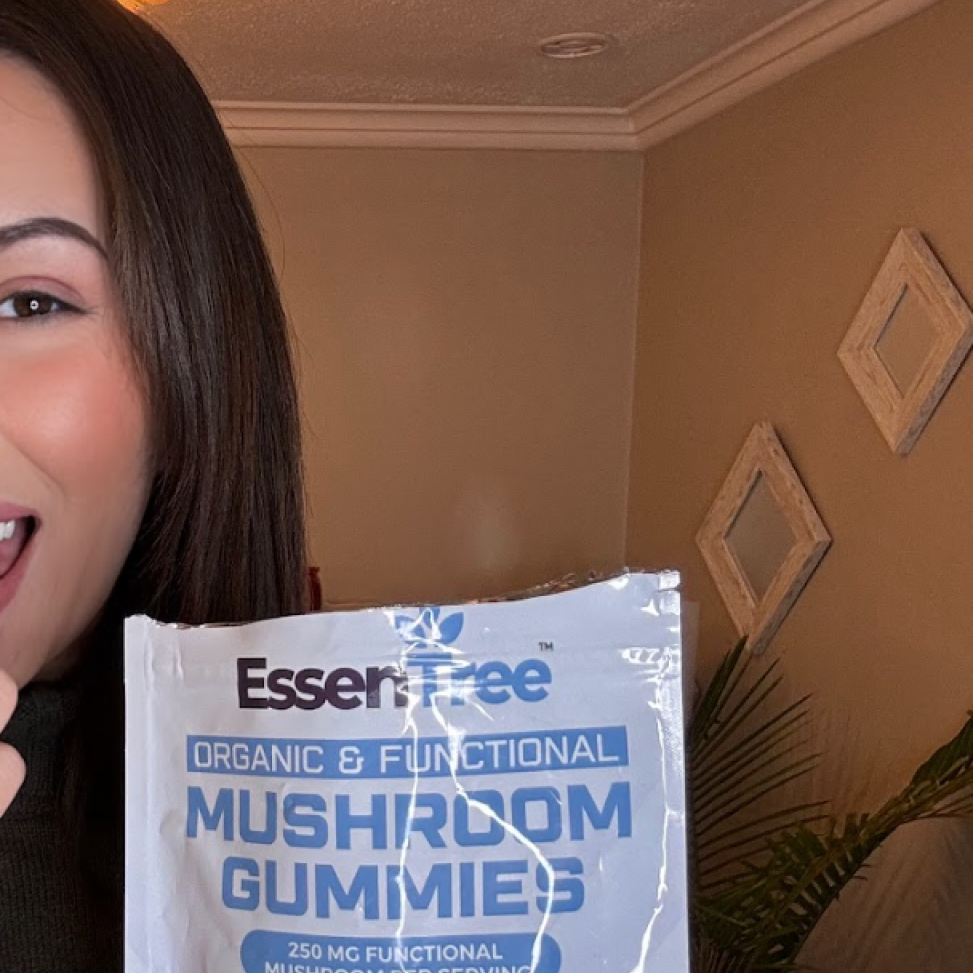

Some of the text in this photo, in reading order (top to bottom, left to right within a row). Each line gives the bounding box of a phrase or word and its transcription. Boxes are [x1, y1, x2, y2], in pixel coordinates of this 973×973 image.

[237, 653, 552, 710] EssenTree
[194, 734, 619, 774] ORGANIC & FUNCTIONAL
[186, 781, 632, 850] MUSHROOM
[222, 856, 585, 920] GUMMIES
[287, 941, 504, 964] 250 MG FUNCTIONAL
